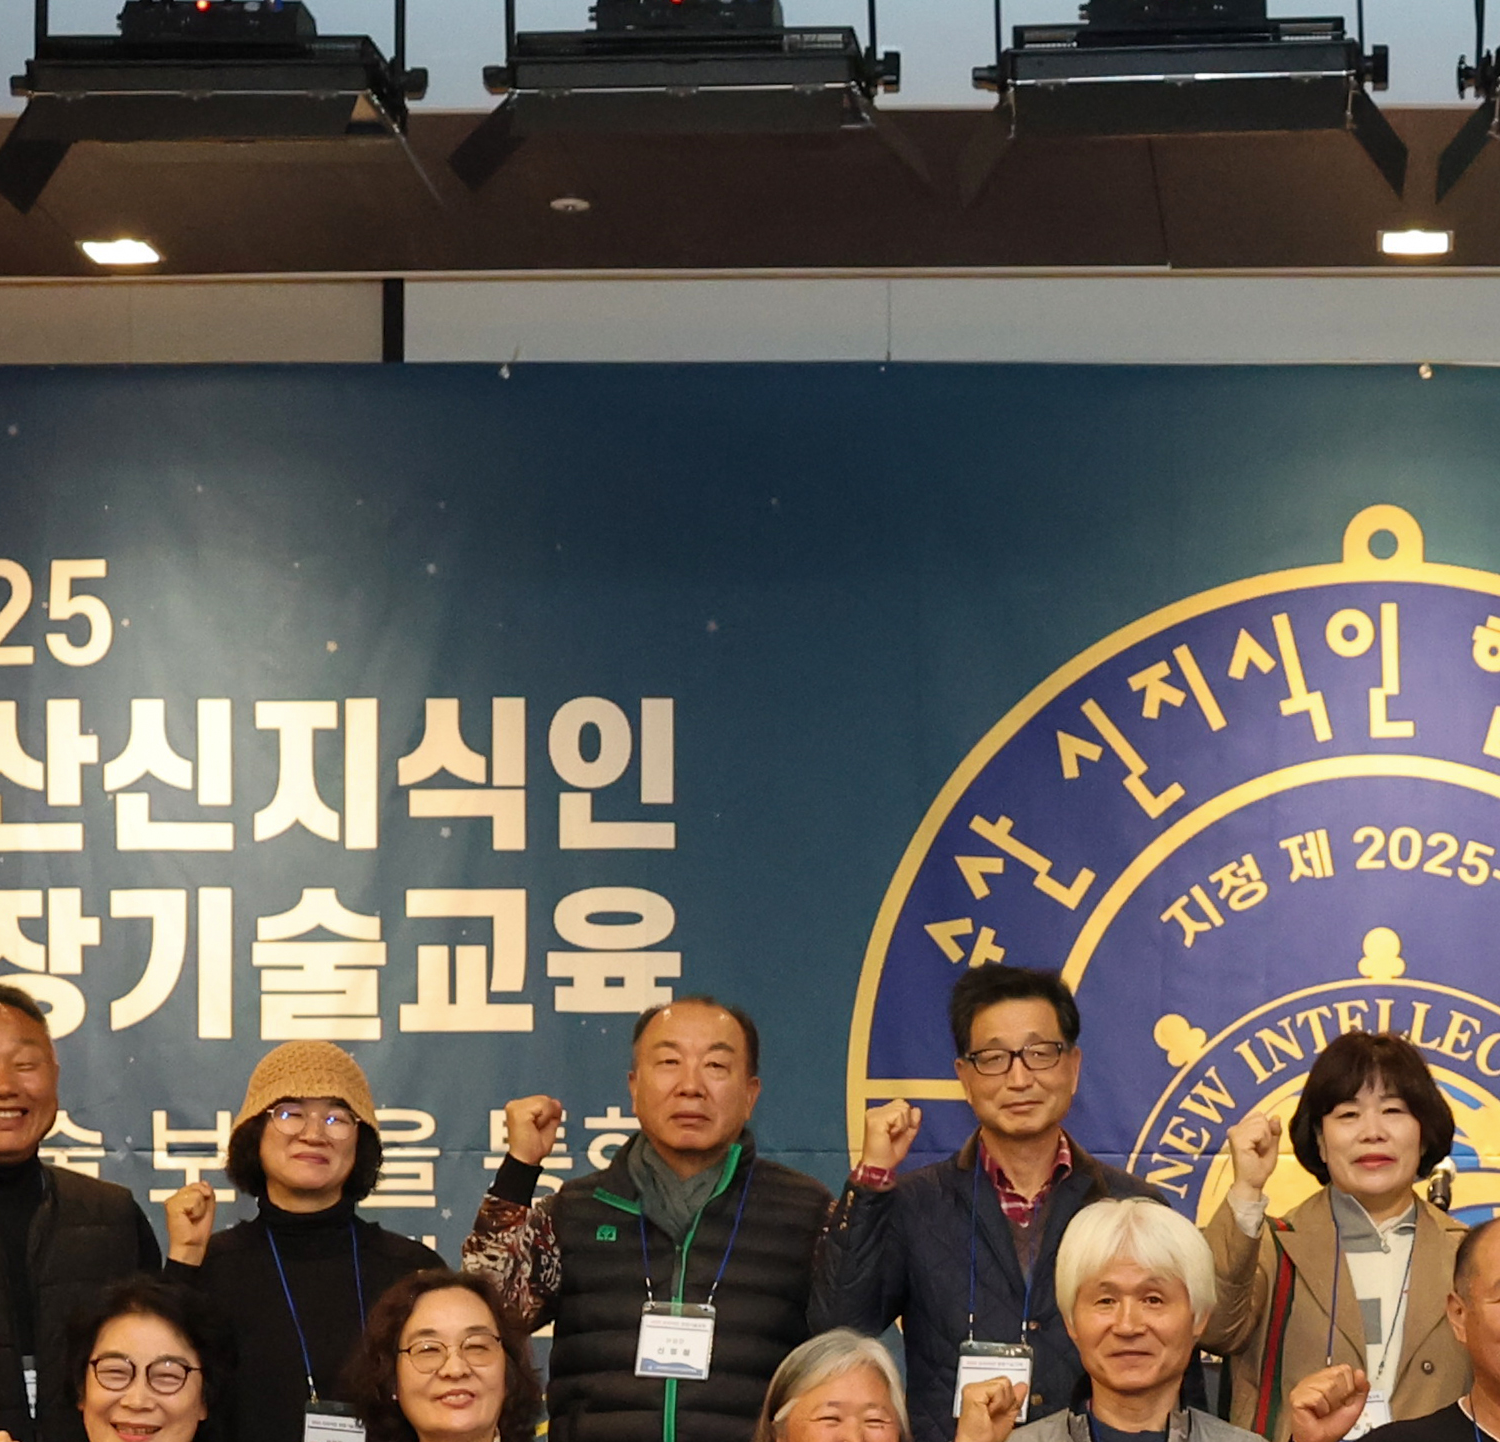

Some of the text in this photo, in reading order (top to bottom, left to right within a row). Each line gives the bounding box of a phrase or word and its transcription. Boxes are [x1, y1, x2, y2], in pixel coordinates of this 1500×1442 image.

[1056, 602, 1415, 819] 신지식인
[1160, 853, 1269, 948] 지정
[1278, 827, 1335, 883] 제
[149, 1107, 440, 1209] 보을
[1145, 1064, 1237, 1200] NEW
